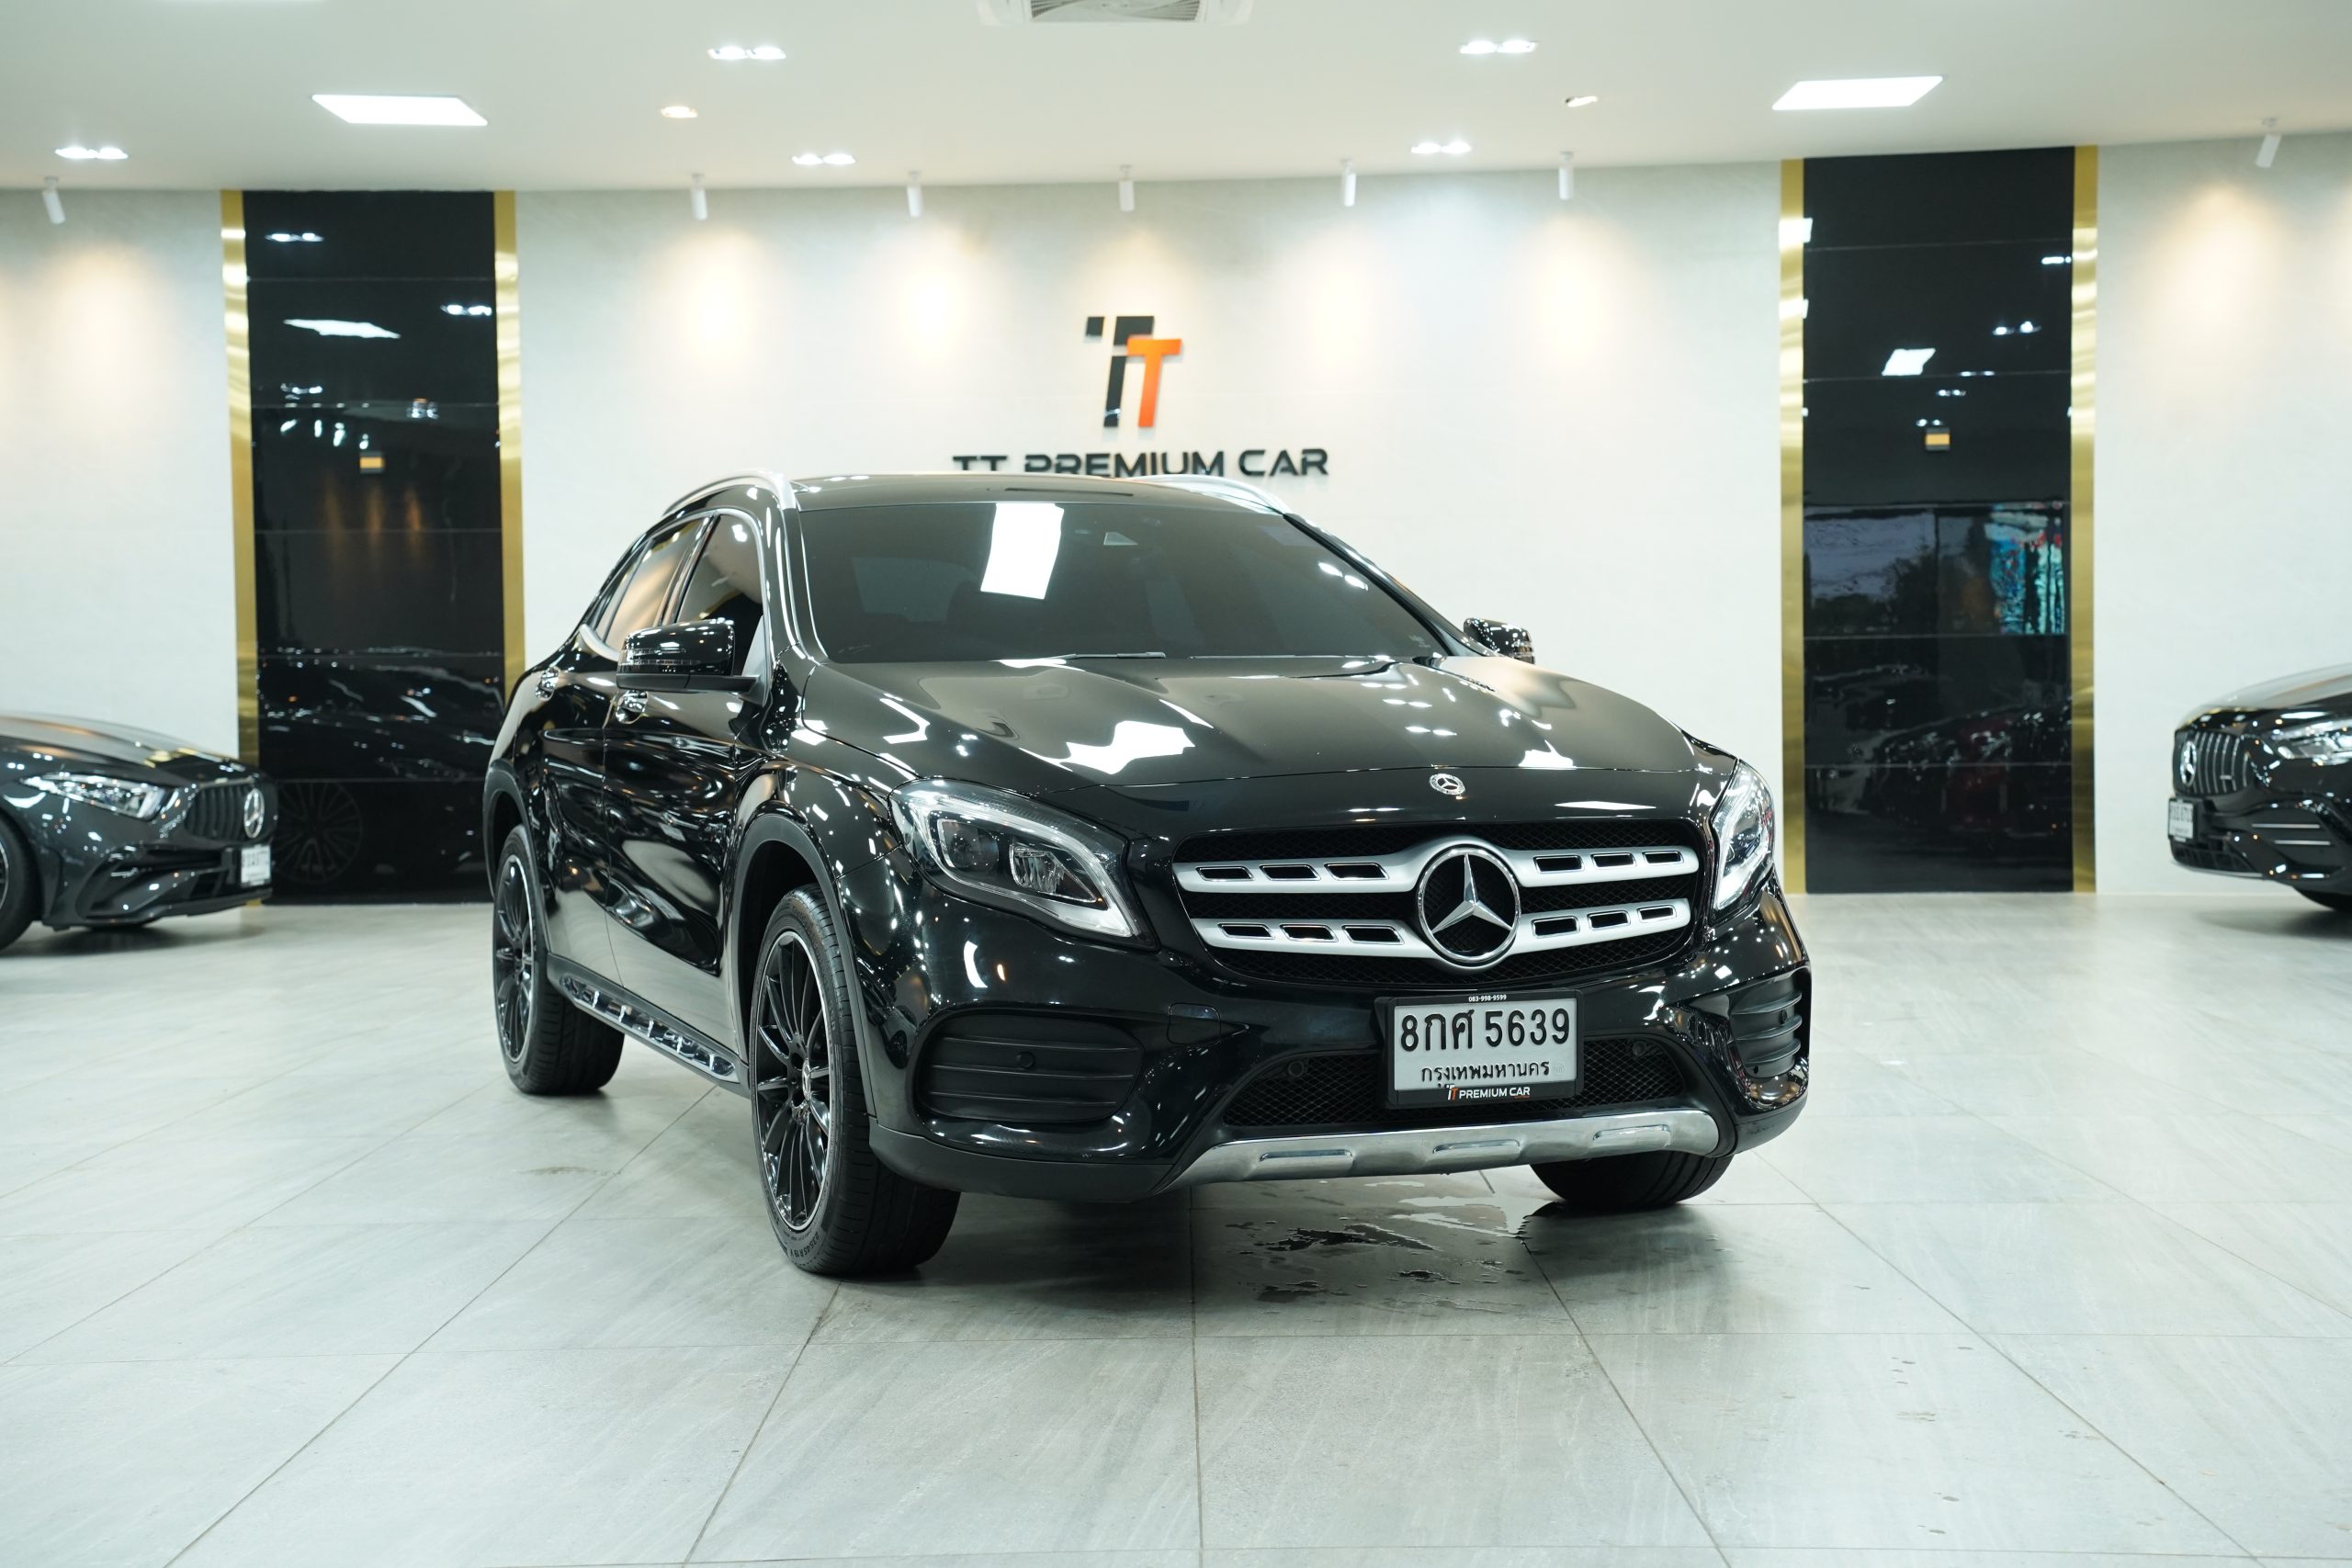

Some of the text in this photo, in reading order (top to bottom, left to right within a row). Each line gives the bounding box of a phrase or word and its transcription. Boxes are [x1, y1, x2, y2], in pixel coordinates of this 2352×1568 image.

[1024, 451, 1225, 479] PREMIUM
[1238, 448, 1329, 477] CAR
[1468, 994, 1508, 1002] 083-998-9599
[1400, 1008, 1570, 1052] 8กศ 5639
[1421, 1061, 1550, 1088] กรุงเทพมหานคร
[1459, 1088, 1508, 1100] PREMIUM
[1509, 1086, 1531, 1097] CAR
